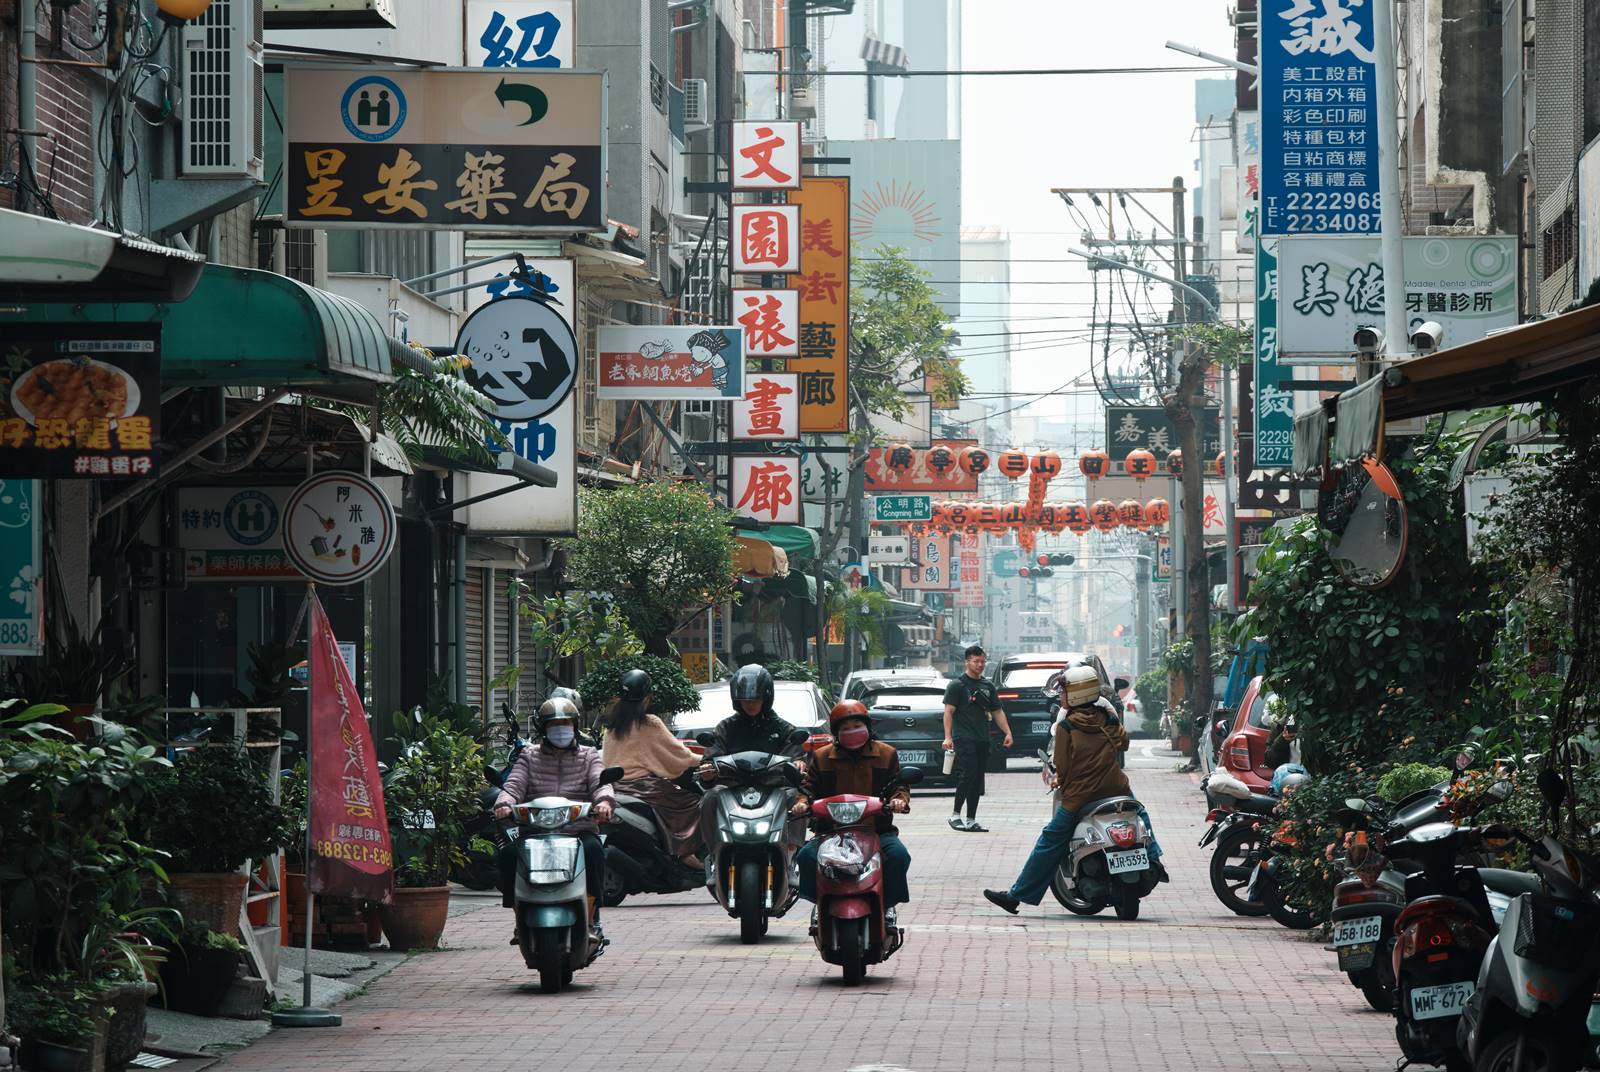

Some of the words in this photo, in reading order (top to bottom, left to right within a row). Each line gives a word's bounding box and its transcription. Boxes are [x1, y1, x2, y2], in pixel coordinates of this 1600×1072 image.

[480, 10, 561, 68] 紹
[1277, 0, 1376, 63] 誠
[1283, 66, 1366, 82] 美工設計
[1283, 108, 1366, 123] 彩色印刷
[1283, 130, 1366, 145] 特種包材
[1283, 151, 1366, 166] 自粘商標
[299, 148, 590, 219] 昱安藥局
[1283, 172, 1366, 187] 各種禮盒
[1286, 193, 1380, 210] 2222968
[1405, 292, 1493, 312] 牙醫診所
[736, 127, 796, 520] 文園裱畫廊
[1114, 413, 1173, 453] 嘉美
[882, 498, 924, 509] 公明路
[182, 509, 221, 529] 特約
[337, 486, 375, 545] 阿米雅
[883, 510, 912, 518] Gongming
